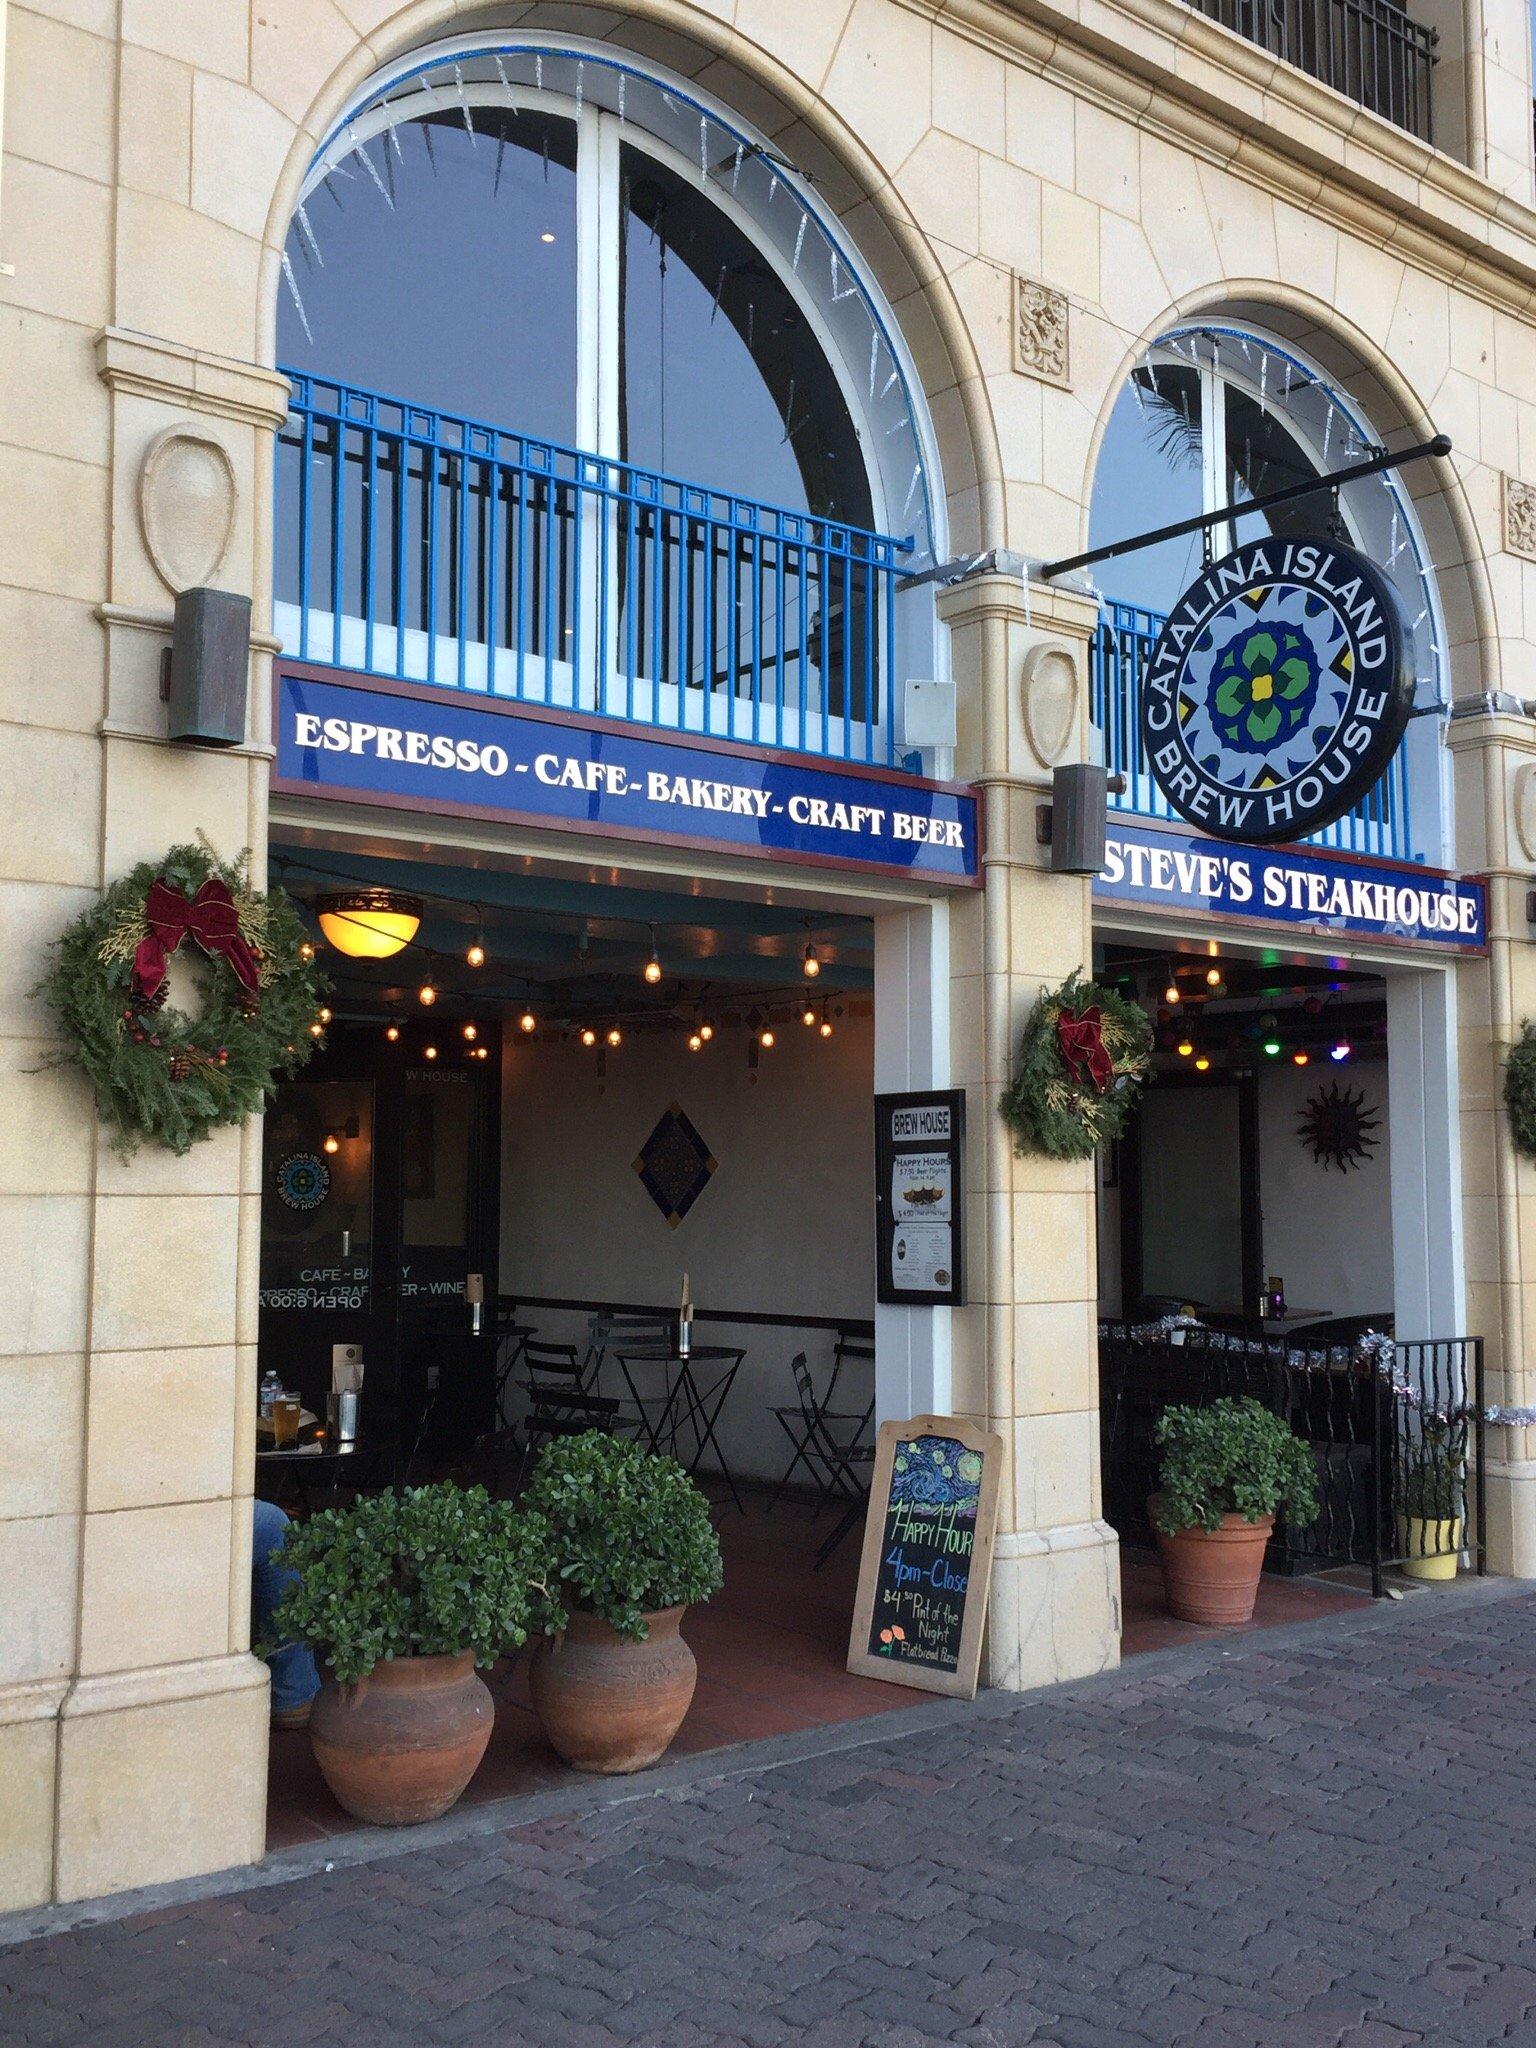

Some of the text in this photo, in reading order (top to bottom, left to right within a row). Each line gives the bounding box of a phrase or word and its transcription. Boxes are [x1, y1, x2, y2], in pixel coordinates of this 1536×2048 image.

[1147, 545, 1388, 731] CATALINA ISLAND
[1153, 688, 1389, 829] BREW HOUSE
[295, 712, 509, 777] ESPRESSO
[788, 796, 885, 836] CRAFT
[892, 812, 965, 849] BEER
[1099, 840, 1479, 934] STEVE'S STEAKHOUSE
[894, 1111, 949, 1135] BREW HOUSE
[277, 1153, 330, 1185] CATALINA ISLAND
[897, 1159, 921, 1167] HAPPY
[277, 1188, 329, 1210] BREW HOUSE
[429, 1281, 466, 1294] WINE
[933, 1500, 974, 1556] HOUR
[911, 1592, 930, 1619] Pint
[931, 1602, 941, 1621] of
[943, 1603, 959, 1626] the
[918, 1621, 950, 1646] Night
[900, 1641, 939, 1661] Flatbread
